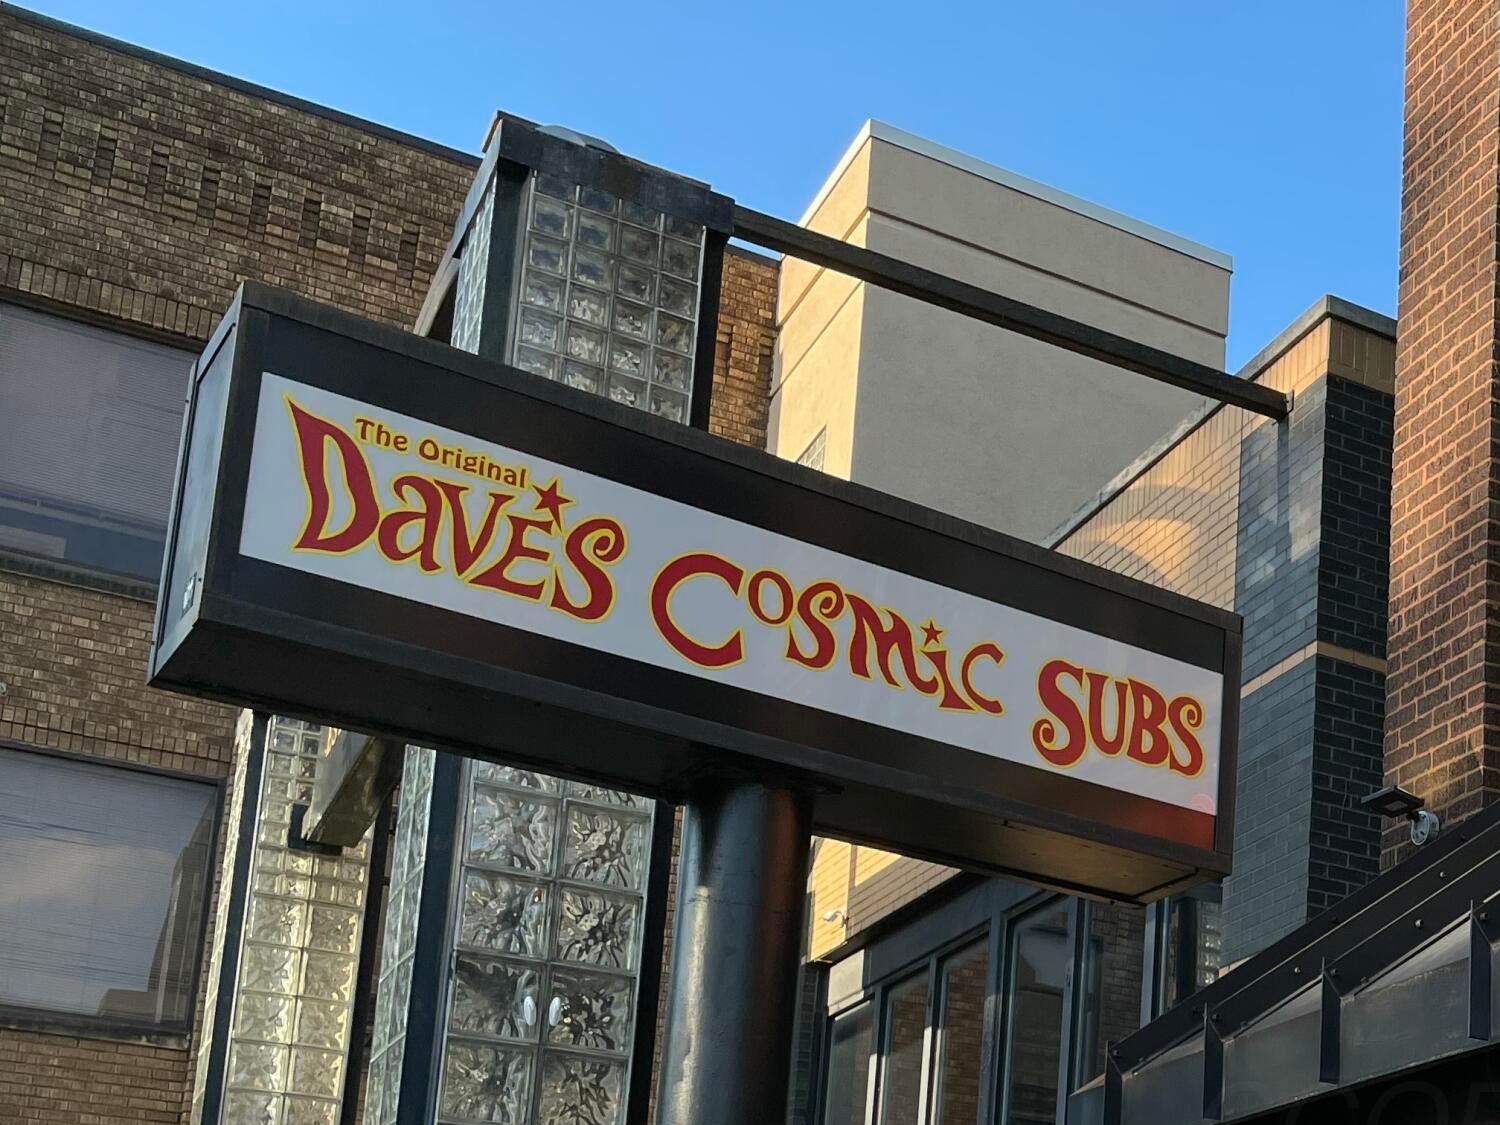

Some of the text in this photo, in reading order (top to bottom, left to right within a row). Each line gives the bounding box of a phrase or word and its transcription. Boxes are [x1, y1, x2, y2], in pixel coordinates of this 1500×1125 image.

[355, 418, 527, 489] The Original
[1031, 658, 1204, 778] SUBS
